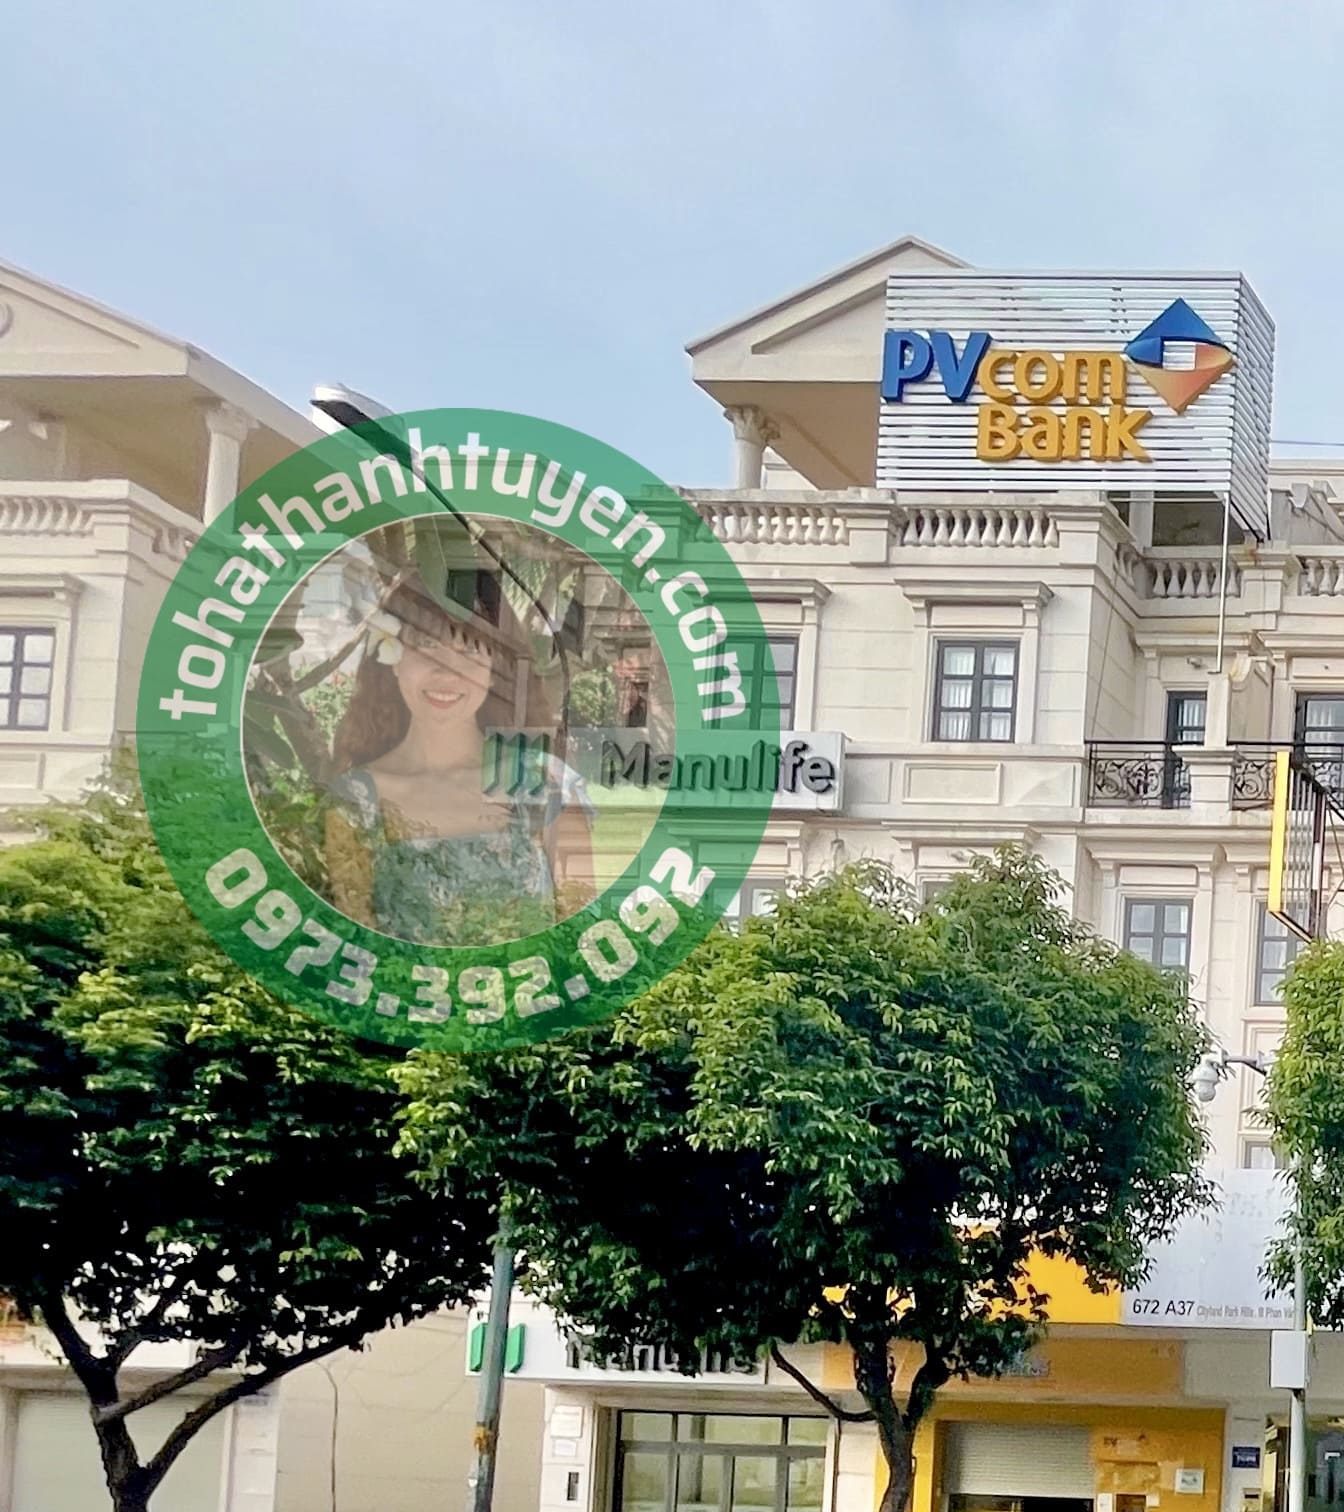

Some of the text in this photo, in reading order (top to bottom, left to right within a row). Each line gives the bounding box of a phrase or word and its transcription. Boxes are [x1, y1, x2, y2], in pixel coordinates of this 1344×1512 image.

[881, 328, 1127, 403] PVcom
[976, 403, 1153, 462] Bank
[603, 739, 836, 793] Manulife
[1132, 1299, 1160, 1315] 672
[1165, 1300, 1195, 1316] A37
